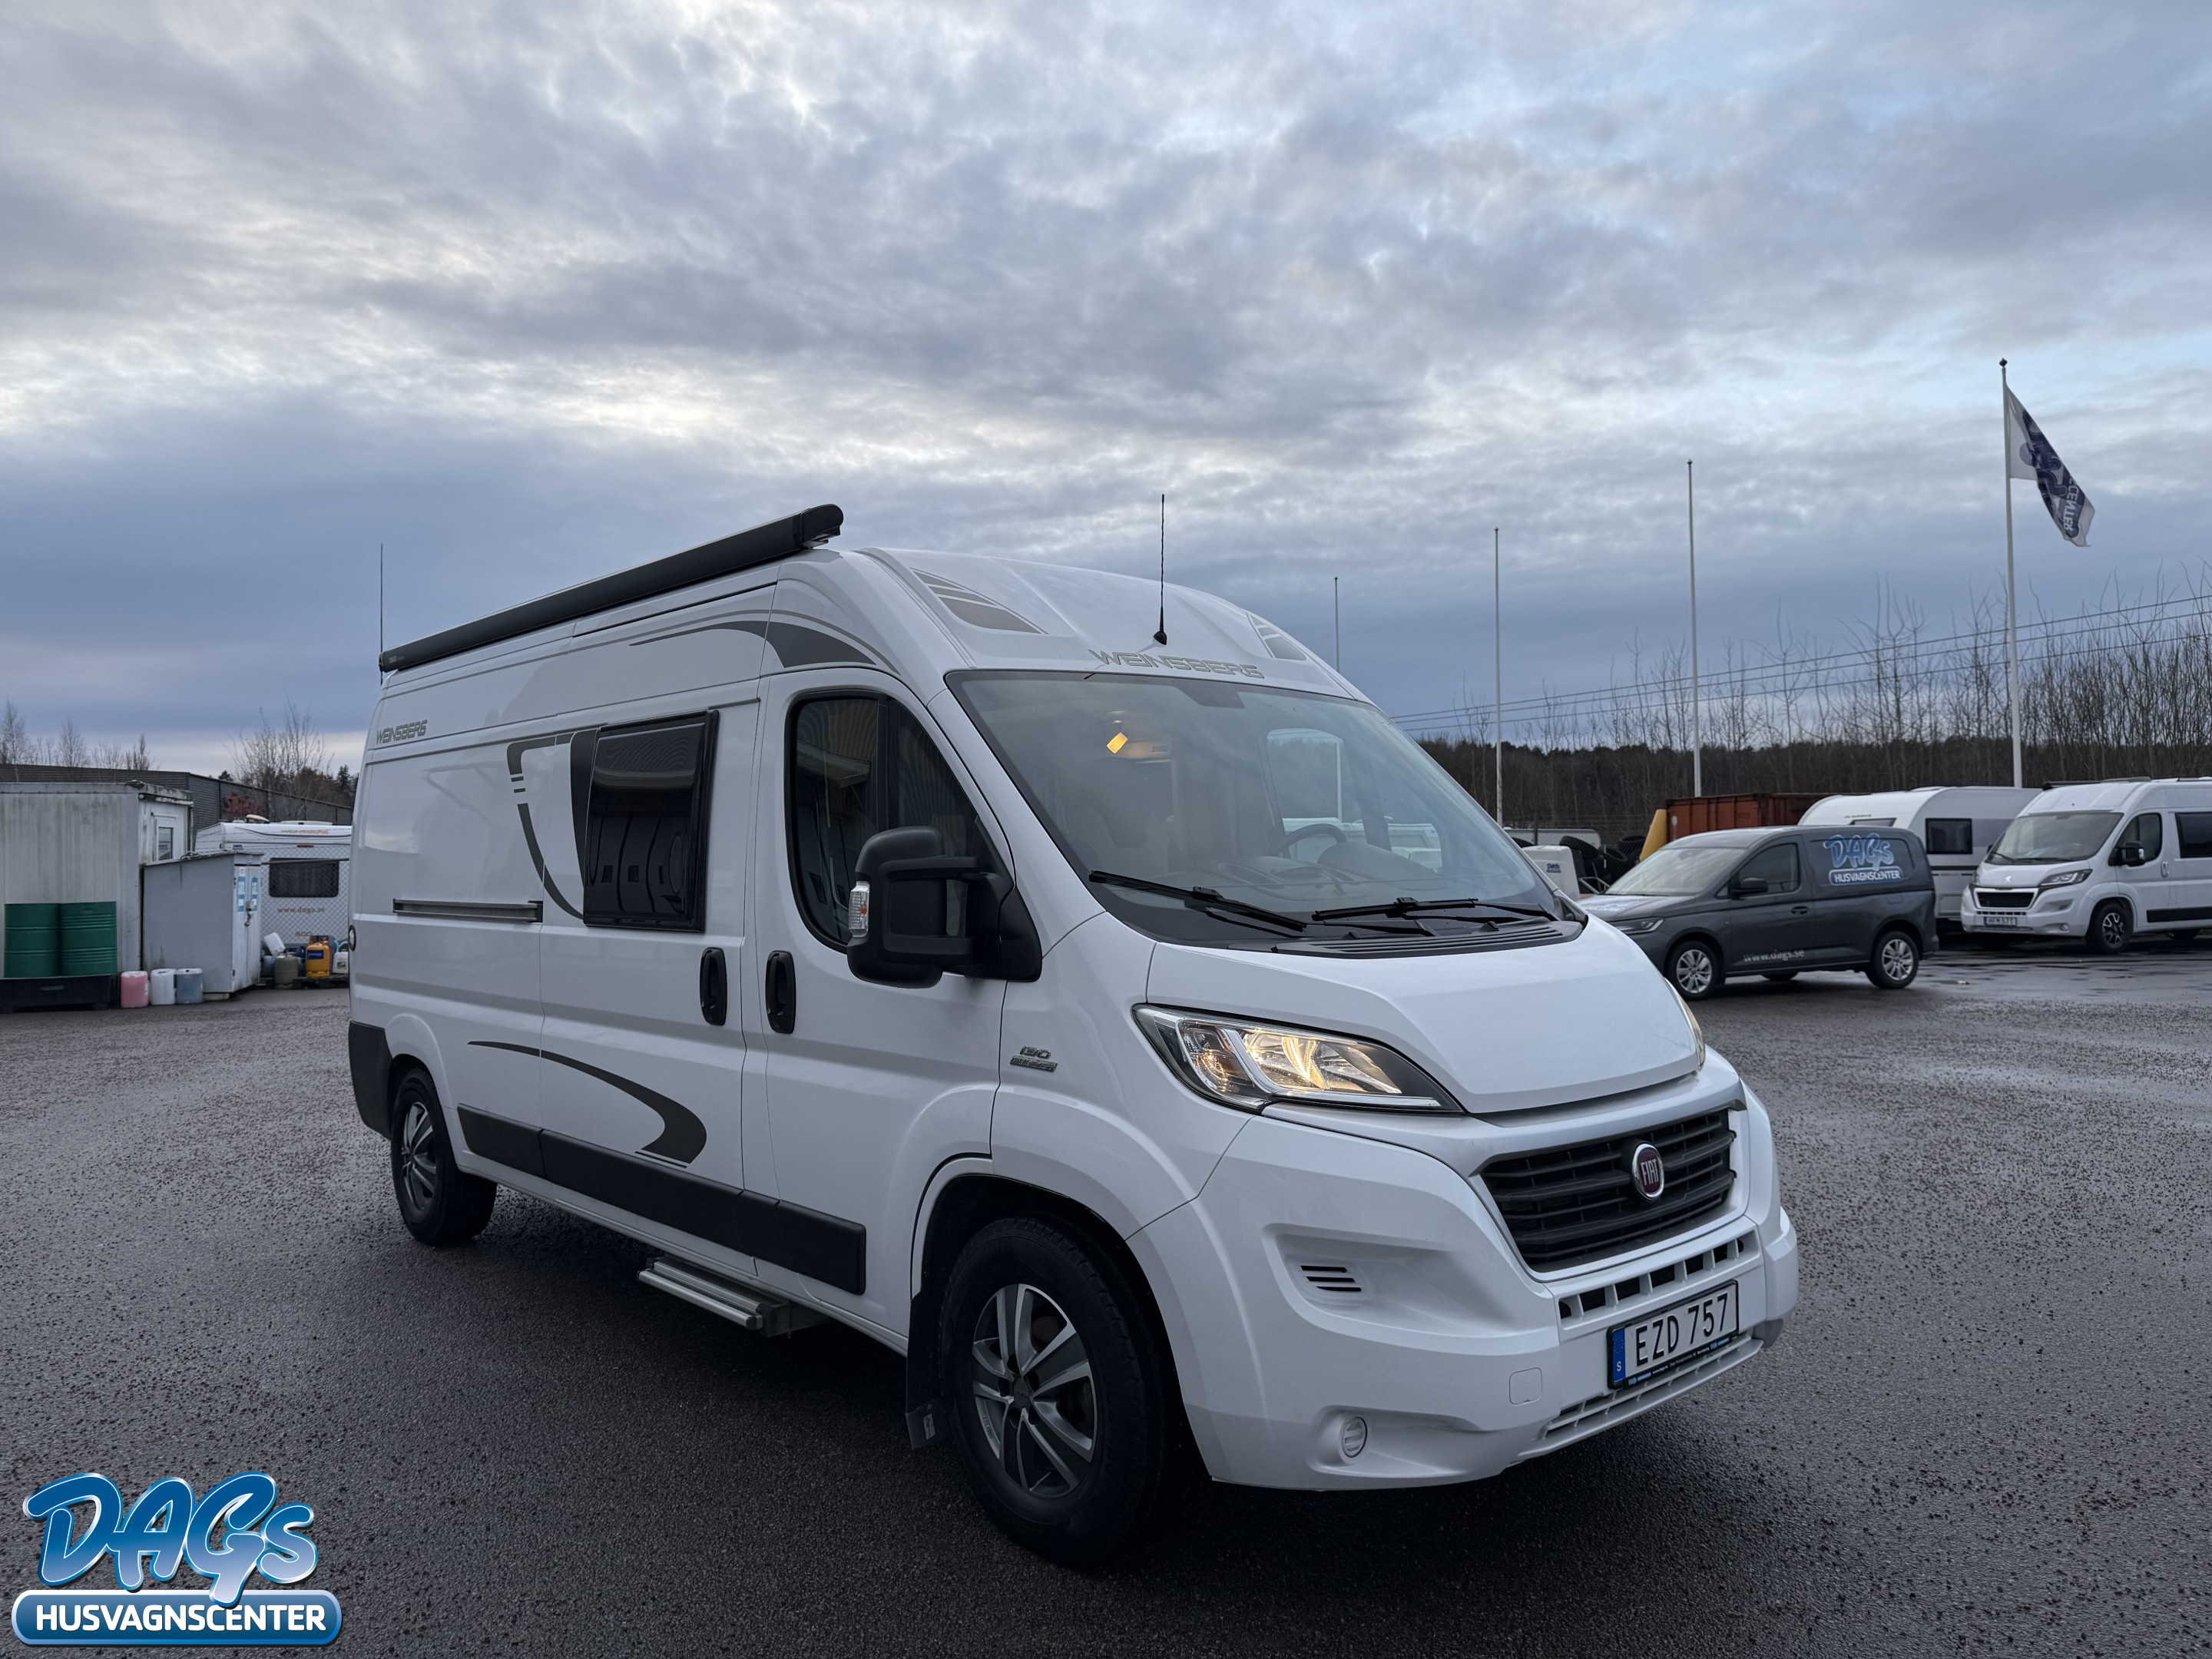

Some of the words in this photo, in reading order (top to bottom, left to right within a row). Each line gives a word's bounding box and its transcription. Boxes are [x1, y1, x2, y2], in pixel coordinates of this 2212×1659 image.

[1088, 649, 1265, 679] WEINSBERG
[376, 719, 428, 746] WEINSBERG
[1834, 870, 1901, 883] HUSVAGNSCENTER
[1640, 1158, 1660, 1187] FIAT
[1635, 1314, 1680, 1367] EZD
[1687, 1292, 1728, 1345] 757
